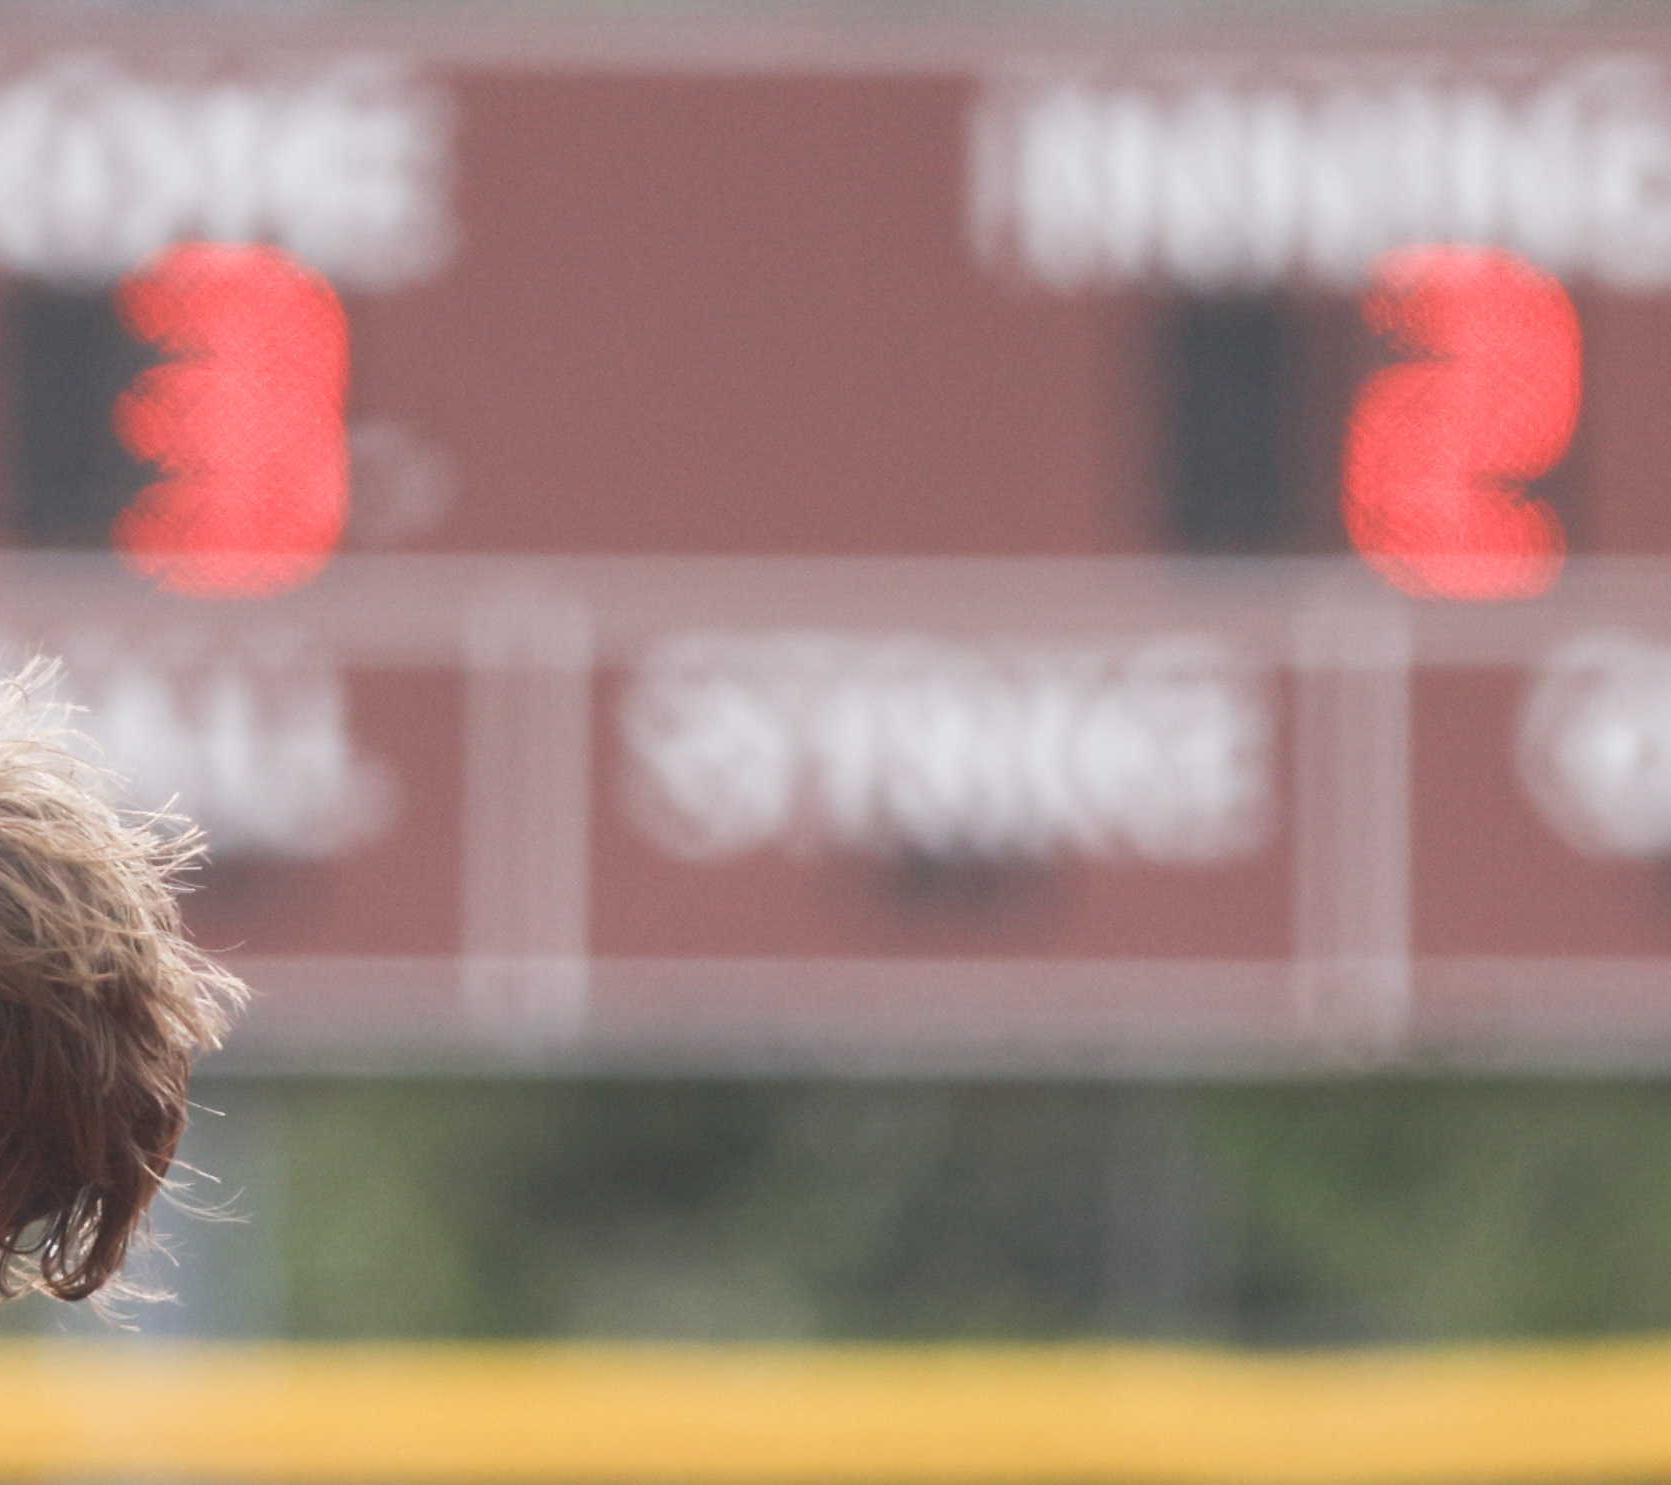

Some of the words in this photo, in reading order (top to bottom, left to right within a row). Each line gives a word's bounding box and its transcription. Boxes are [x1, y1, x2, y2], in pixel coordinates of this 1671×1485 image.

[112, 241, 350, 600] 3
[1340, 241, 1583, 600] 2
[618, 640, 1272, 862] STRIKE
